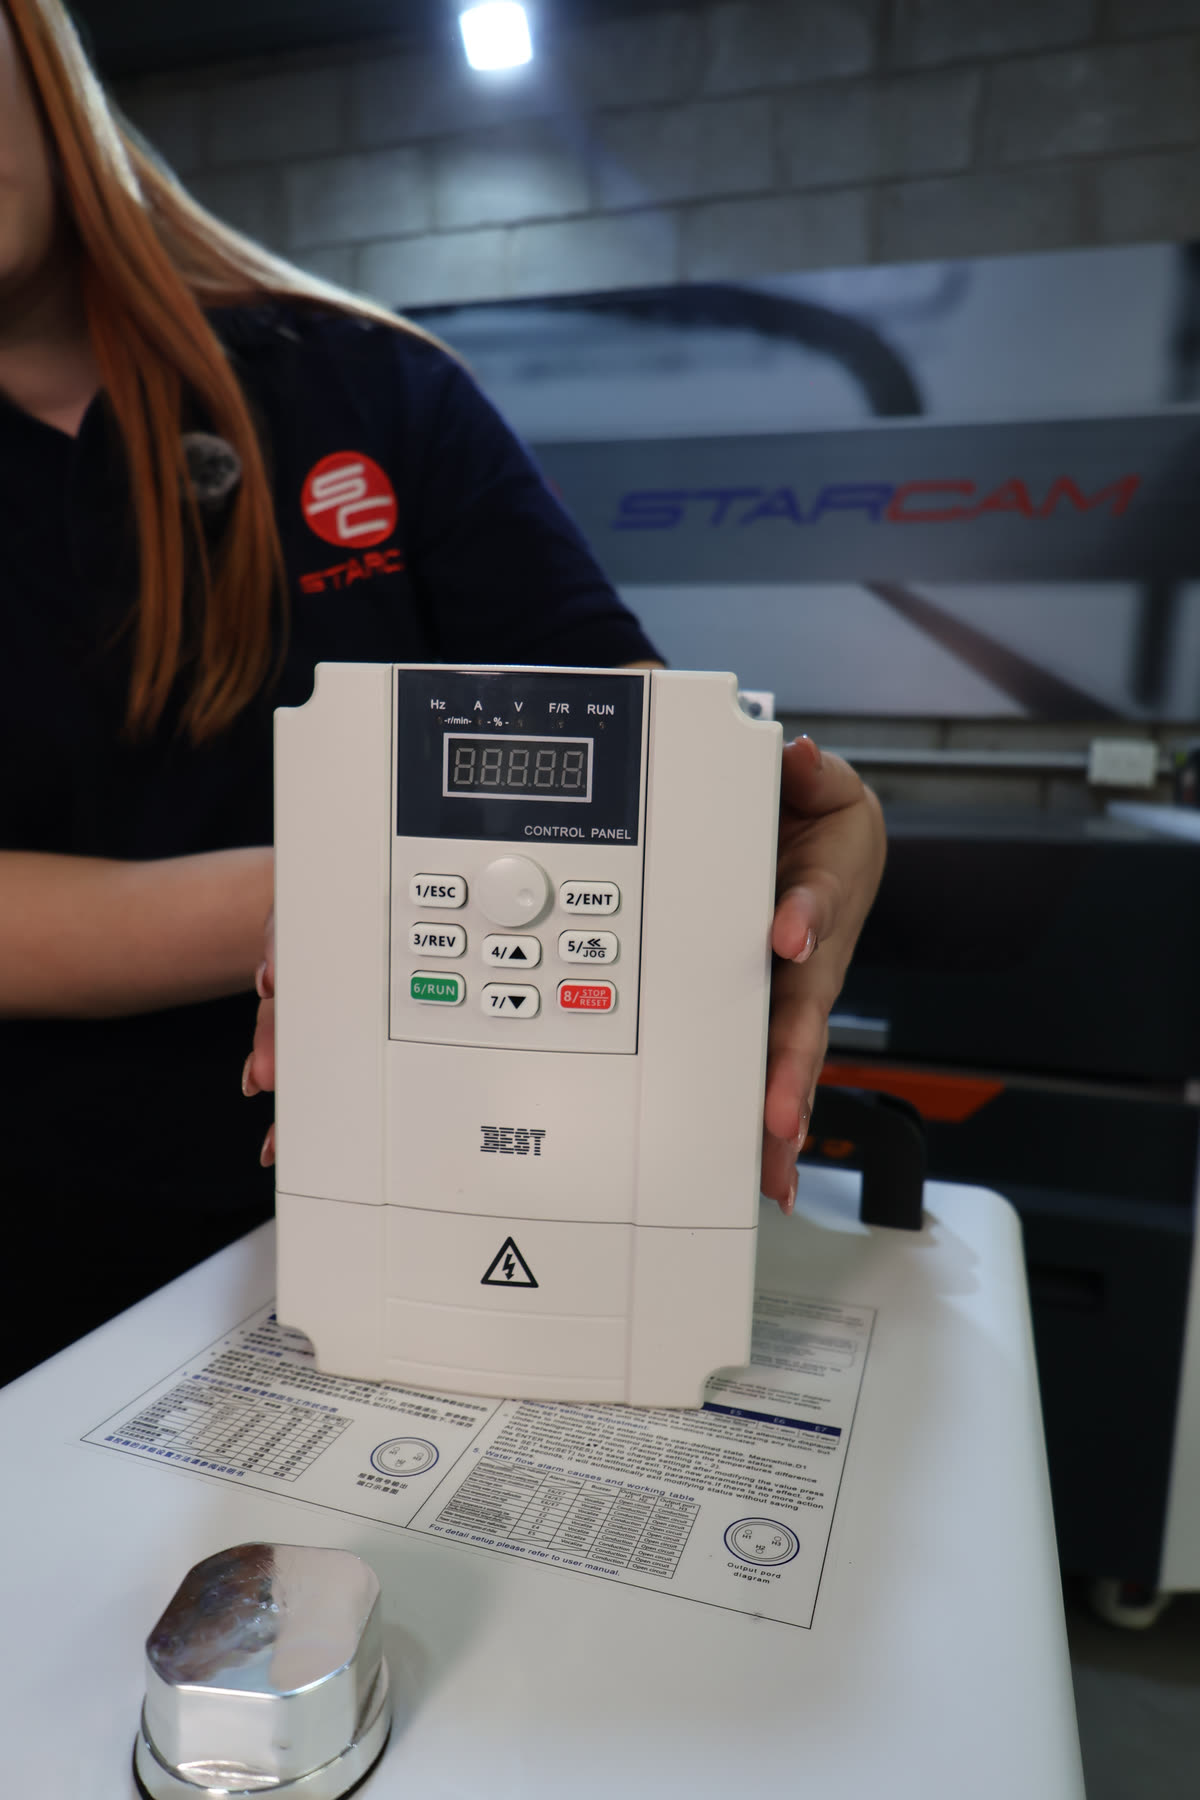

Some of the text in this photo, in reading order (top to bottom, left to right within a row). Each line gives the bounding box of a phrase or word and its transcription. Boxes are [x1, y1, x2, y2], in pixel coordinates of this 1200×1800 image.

[612, 473, 1140, 531] STARCAM
[299, 549, 403, 594] STARC
[430, 699, 615, 716] Hz A V F/R RUN
[524, 825, 632, 840] CONTROL PANEL
[415, 884, 457, 899] 1/ESC
[566, 893, 613, 907] 2/ENT
[413, 934, 456, 948] 3/REV
[582, 949, 606, 959] JOG
[413, 983, 456, 997] 6/RUN
[582, 989, 606, 998] STOP
[579, 1000, 608, 1008] RESET
[480, 1125, 546, 1156] BEST
[485, 1450, 513, 1461] Water
[514, 1457, 535, 1466] flow
[537, 1463, 565, 1473] alarm
[567, 1470, 602, 1482] causes
[604, 1478, 624, 1486] and
[626, 1483, 666, 1497] working
[669, 1491, 695, 1502] table
[600, 1534, 634, 1547] Conduction
[604, 1528, 637, 1540] Conduction
[428, 1523, 444, 1532] For
[445, 1528, 470, 1538] detail
[470, 1535, 495, 1545] setup
[495, 1541, 526, 1553] please
[527, 1549, 550, 1558] refer
[562, 1558, 583, 1567] user
[598, 1541, 631, 1552] Conduction
[591, 1553, 625, 1565] Conduction
[594, 1547, 628, 1558] Conduction
[727, 1562, 782, 1579] Output pord
[733, 1572, 770, 1584] diagram
